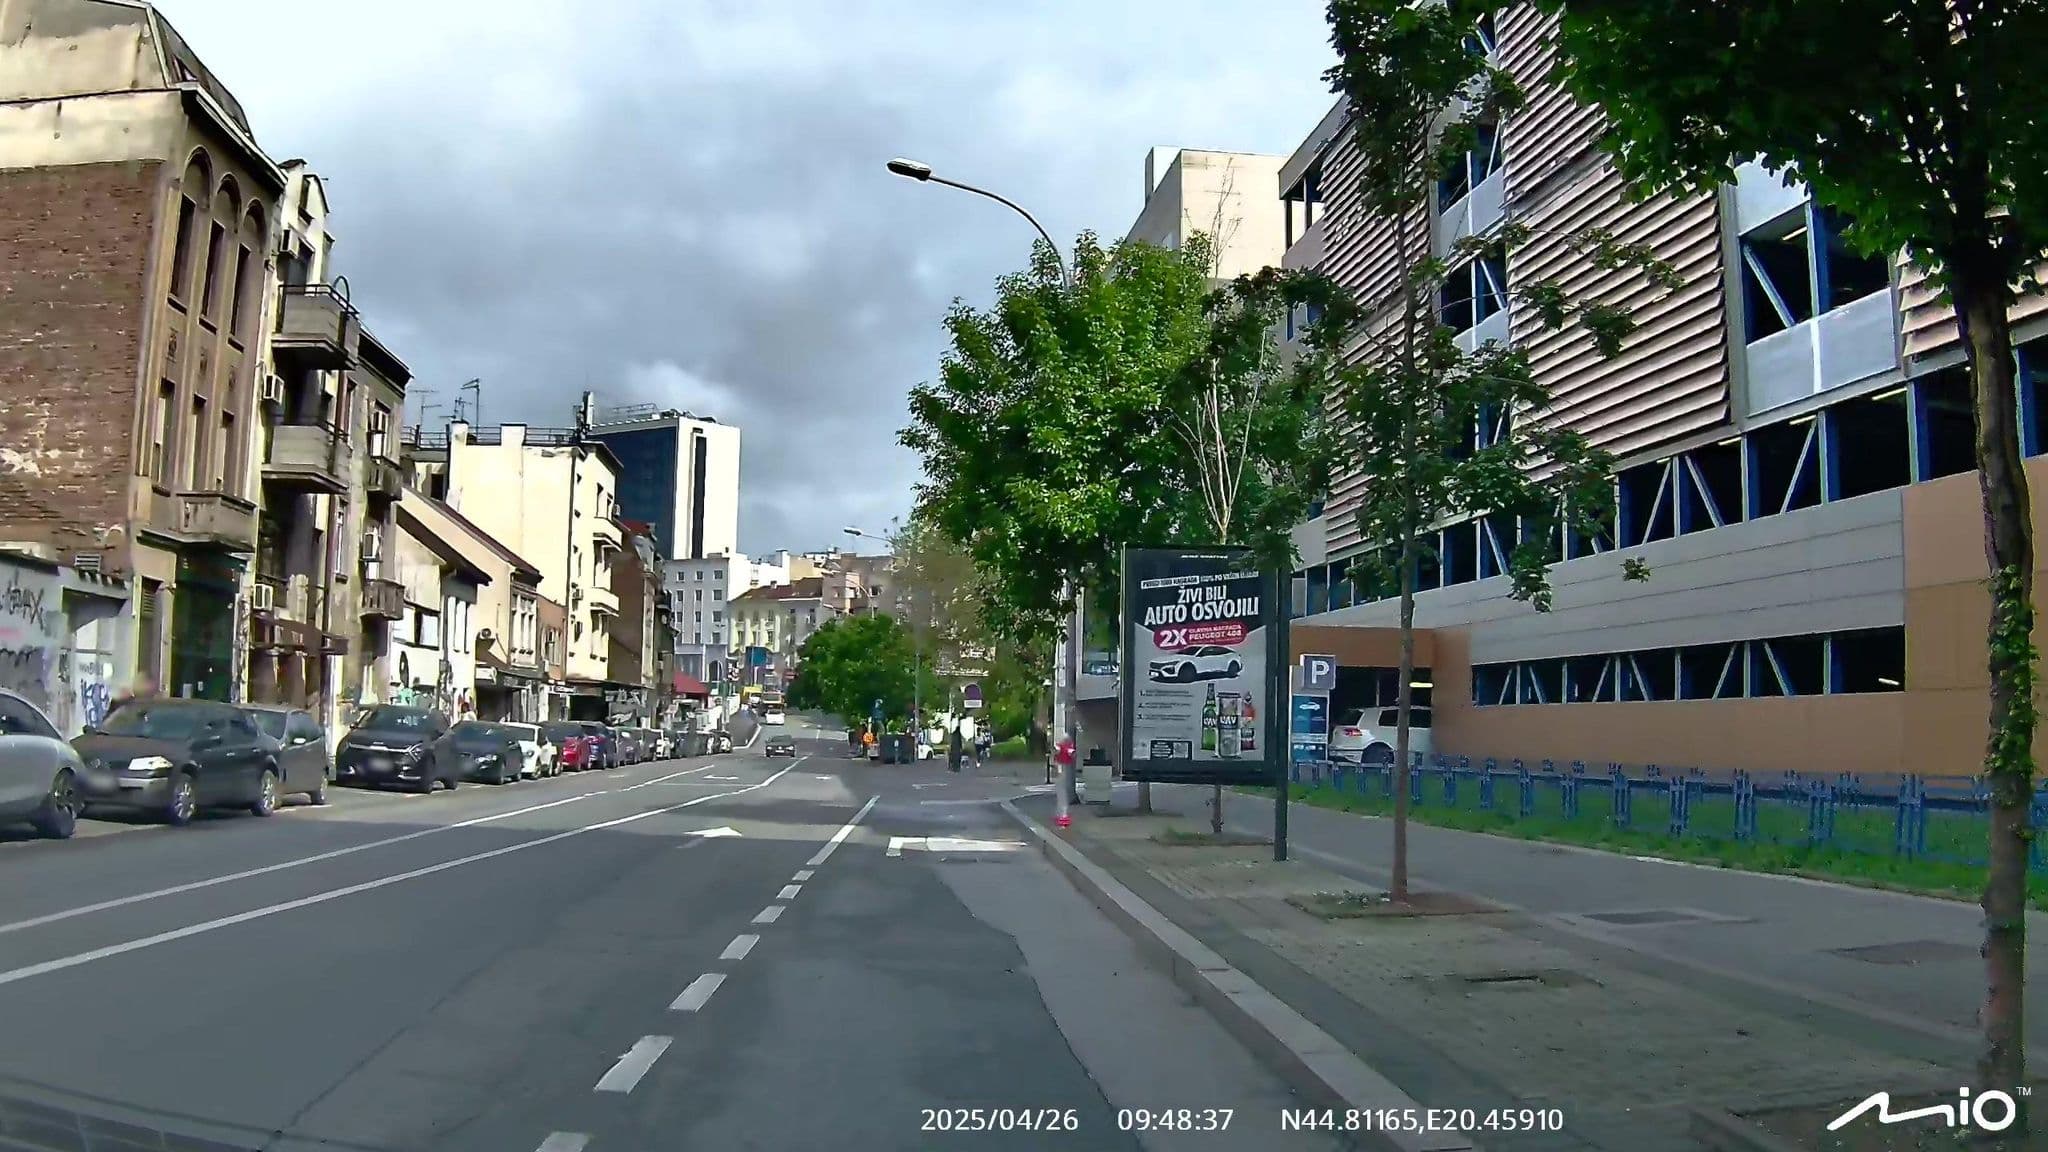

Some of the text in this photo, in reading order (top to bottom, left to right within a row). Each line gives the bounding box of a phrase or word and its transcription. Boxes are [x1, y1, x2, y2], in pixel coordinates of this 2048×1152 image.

[1178, 585, 1227, 604] ŽIVI BILI
[1144, 597, 1259, 626] AUTO OSVOJILI
[1160, 628, 1188, 648] 2X
[1189, 631, 1225, 640] PEUGEOT
[1311, 660, 1330, 684] P
